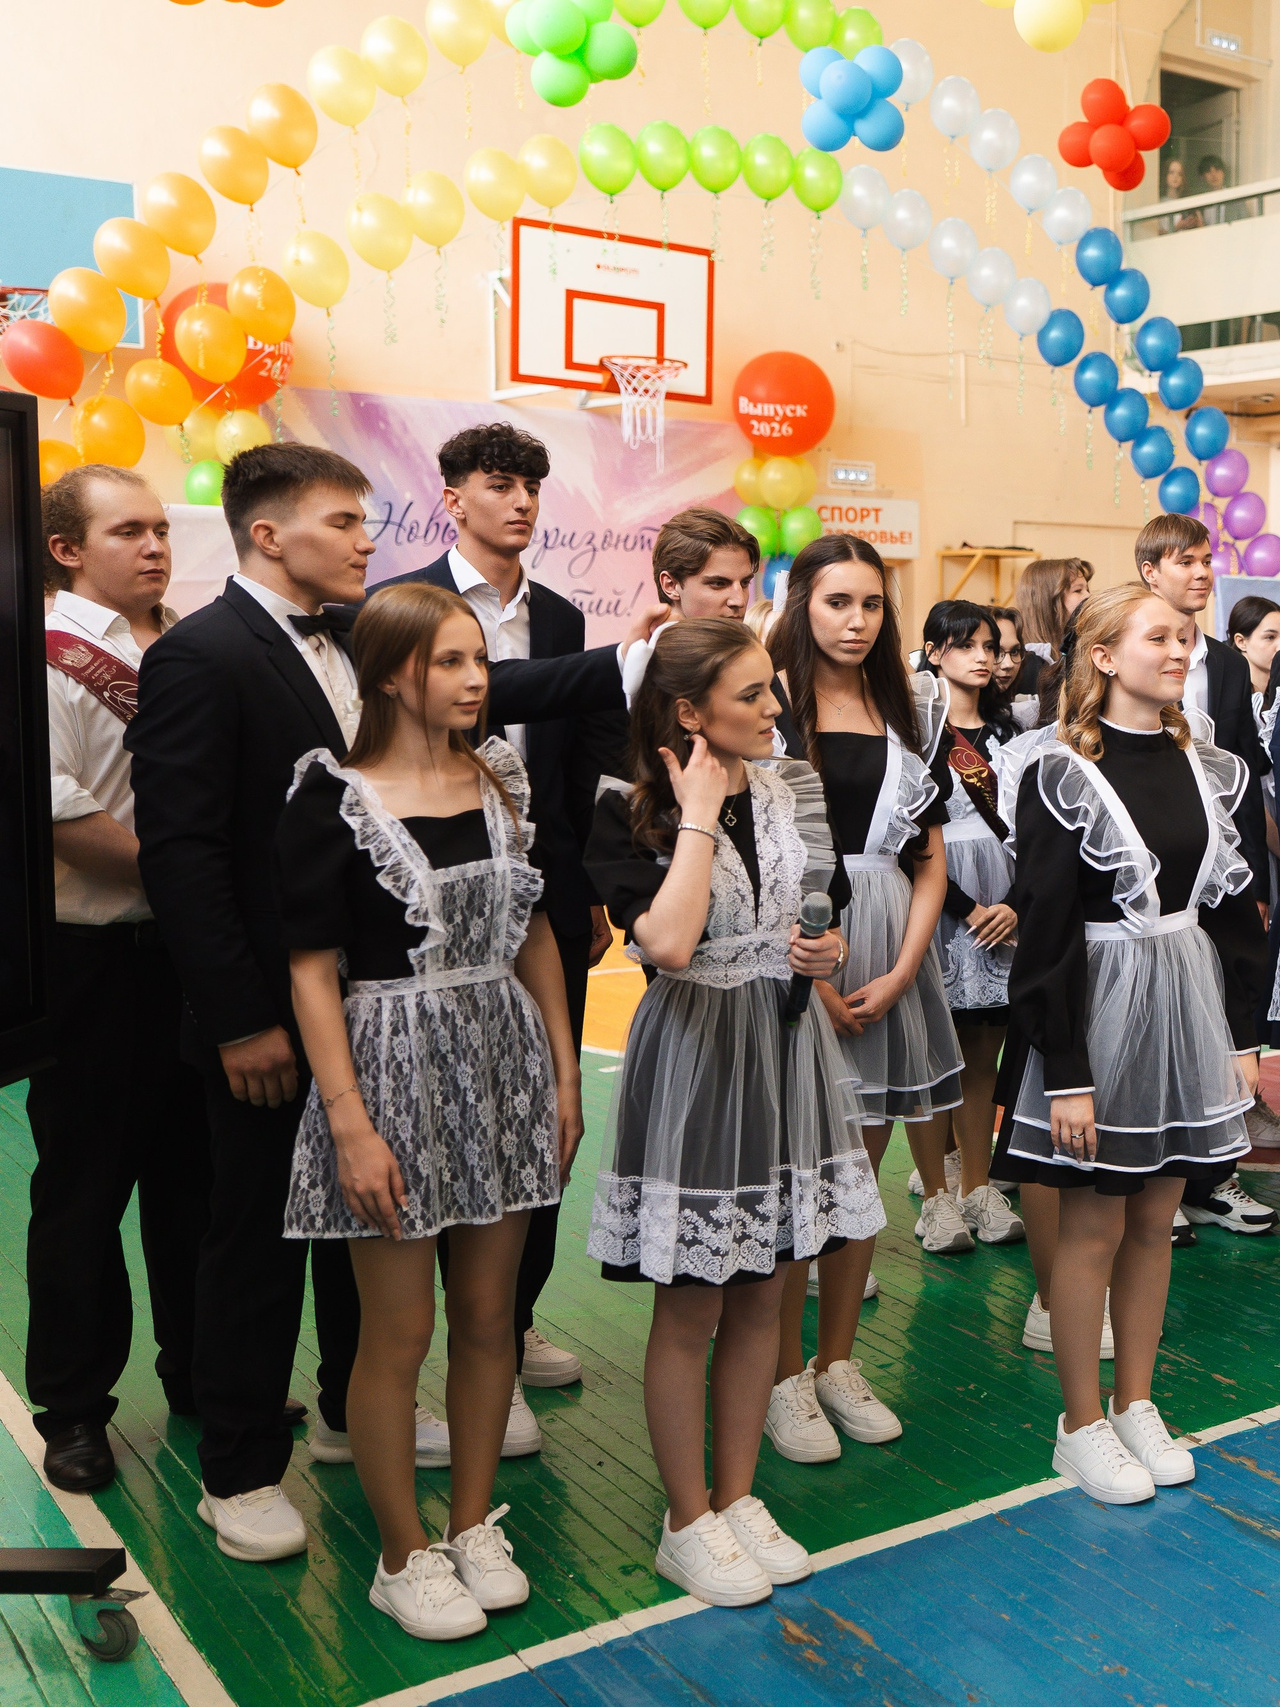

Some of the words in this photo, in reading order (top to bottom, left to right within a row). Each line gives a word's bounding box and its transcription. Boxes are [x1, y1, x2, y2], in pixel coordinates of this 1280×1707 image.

[738, 396, 808, 421] Выпуск
[749, 419, 793, 438] 2026
[361, 497, 459, 547] Новы
[816, 505, 883, 524] СПОРТ
